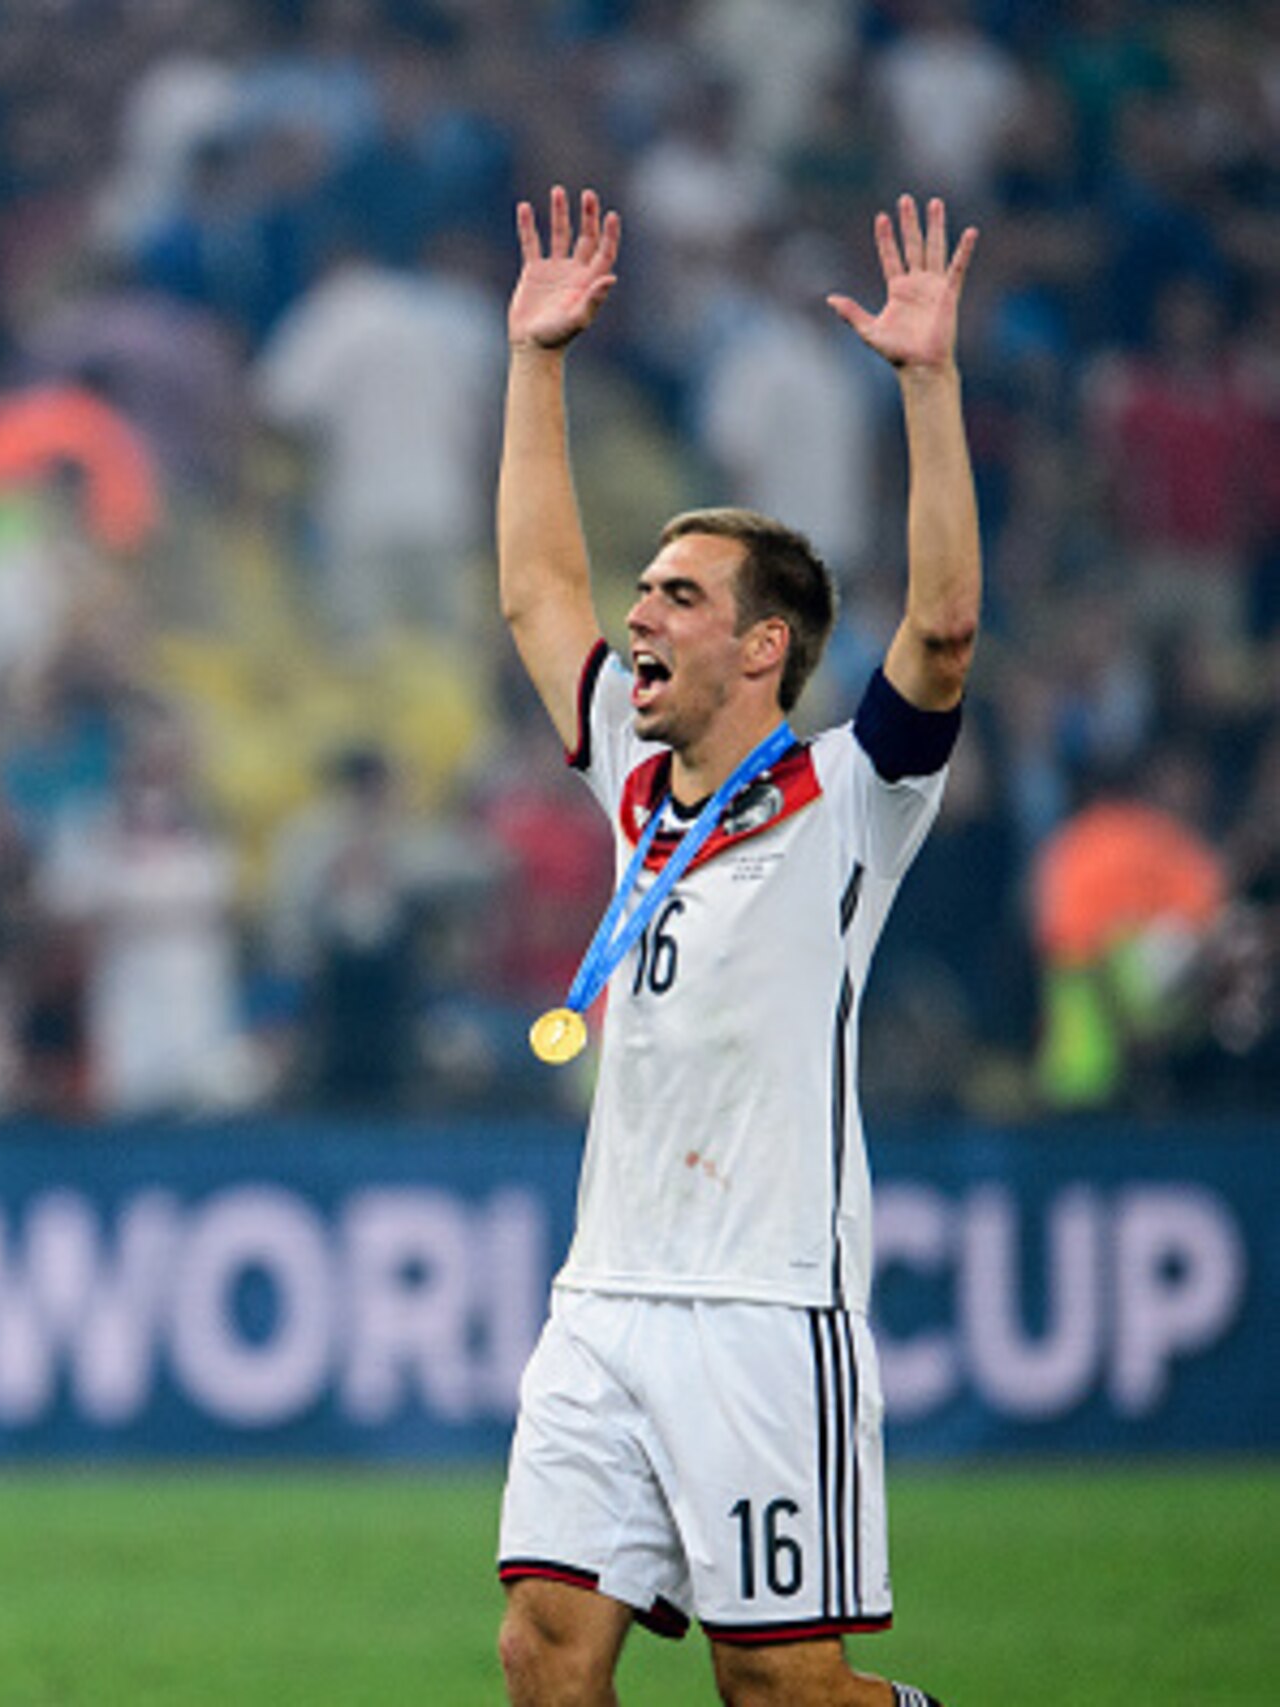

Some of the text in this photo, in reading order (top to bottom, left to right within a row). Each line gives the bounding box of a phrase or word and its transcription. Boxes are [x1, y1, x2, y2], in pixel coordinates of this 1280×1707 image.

[632, 899, 685, 996] 16
[872, 1184, 1246, 1416] CUP
[728, 1498, 803, 1599] 16
